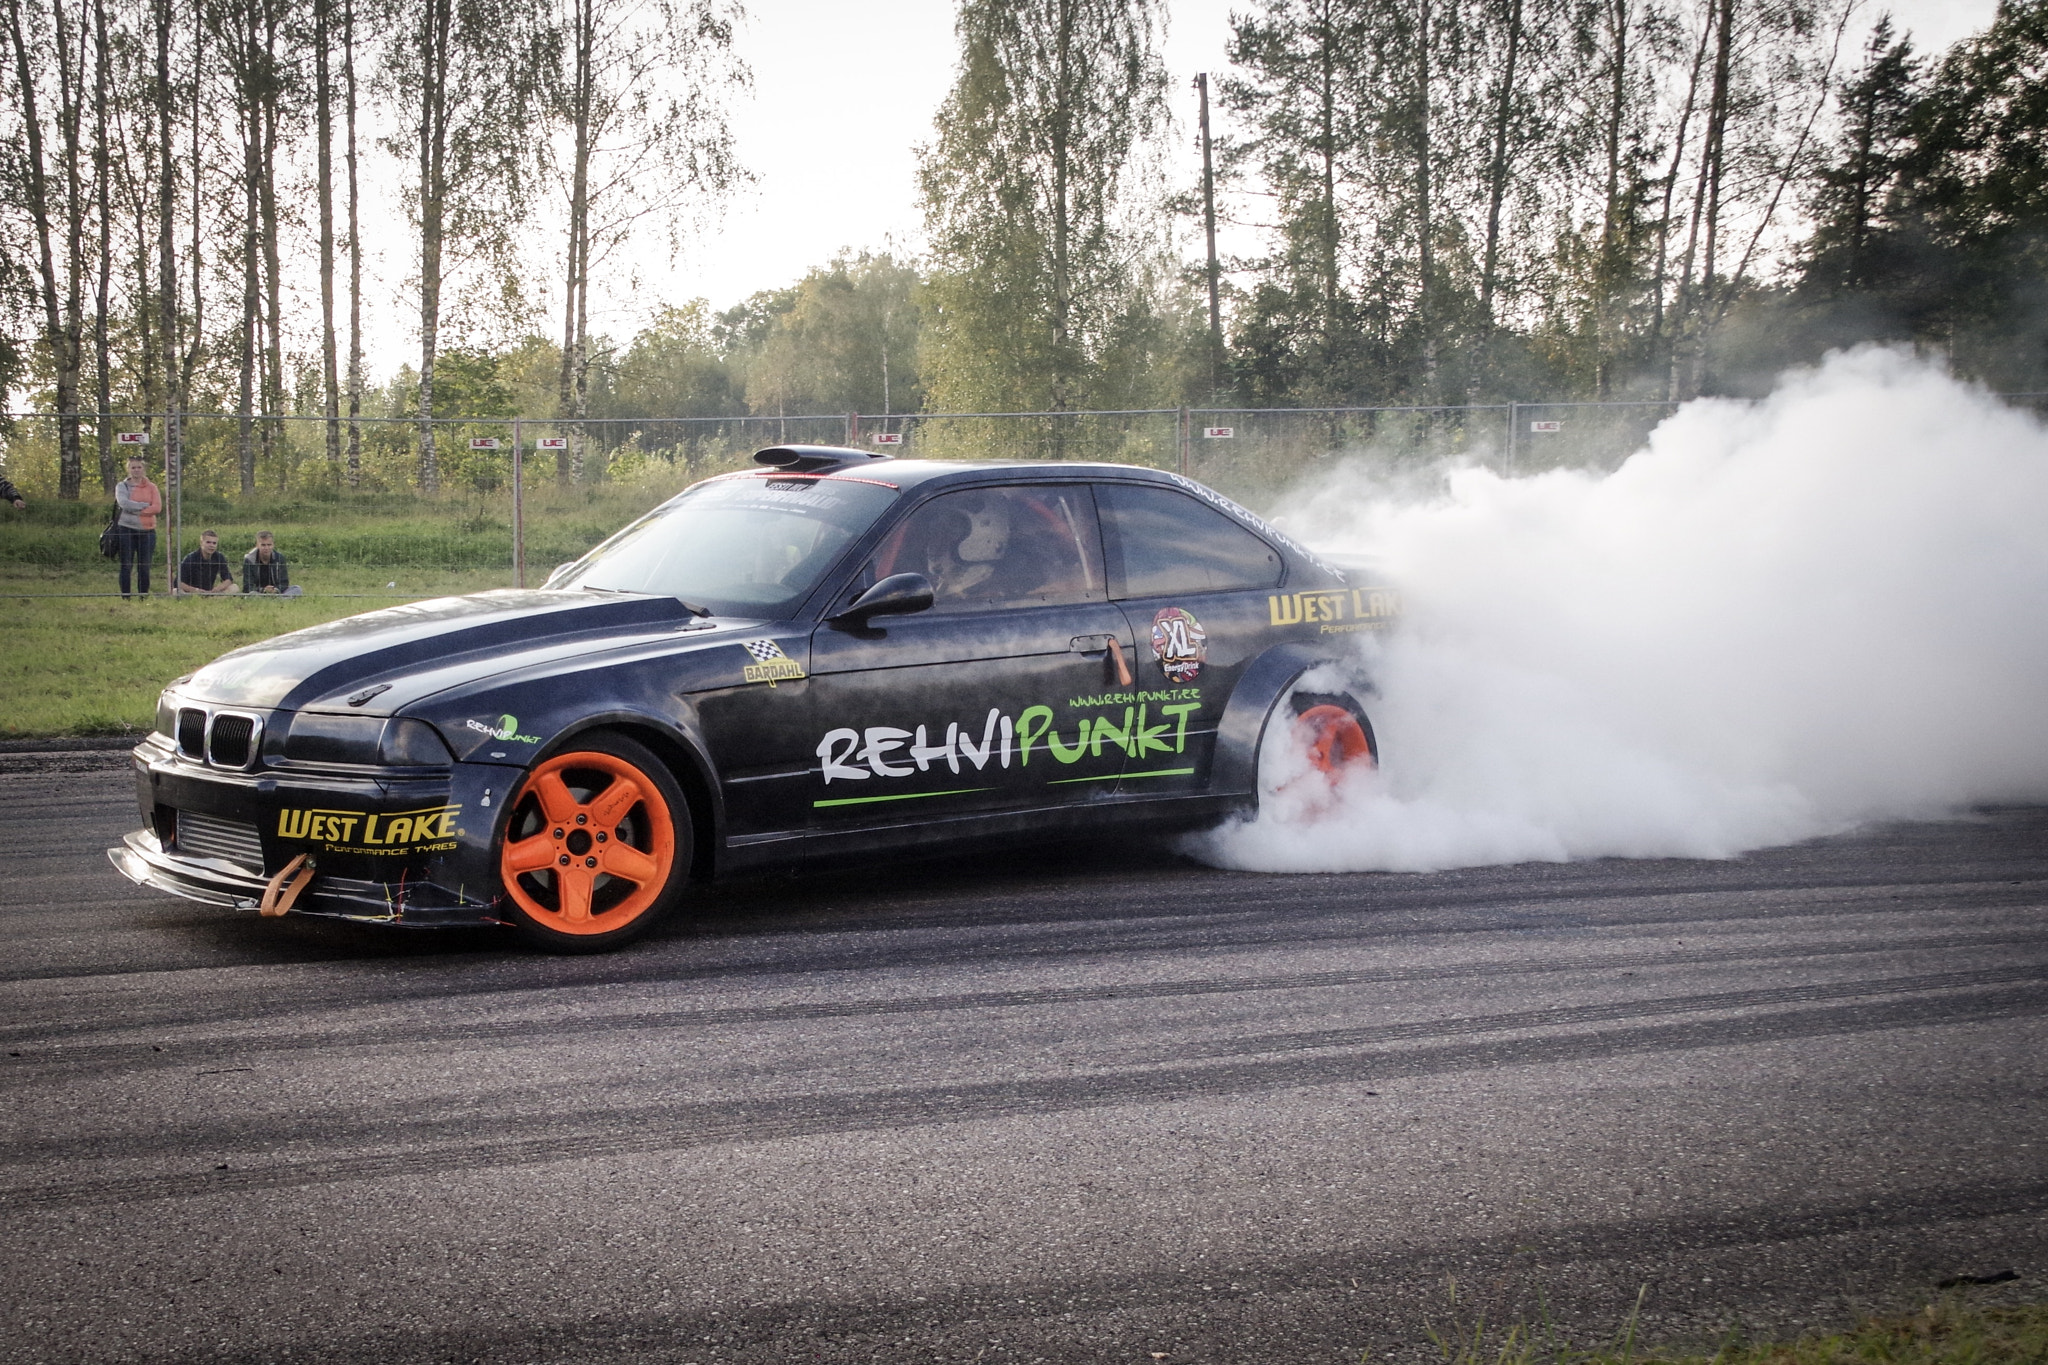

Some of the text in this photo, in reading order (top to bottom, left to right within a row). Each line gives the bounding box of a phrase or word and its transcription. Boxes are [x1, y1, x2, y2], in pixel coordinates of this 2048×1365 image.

[1268, 586, 1405, 626] WEST LAK
[1160, 620, 1196, 658] XL
[745, 664, 803, 685] BARDAHL
[277, 804, 463, 844] WEST LAKE
[325, 841, 458, 856] PERFORMANCE TYRES
